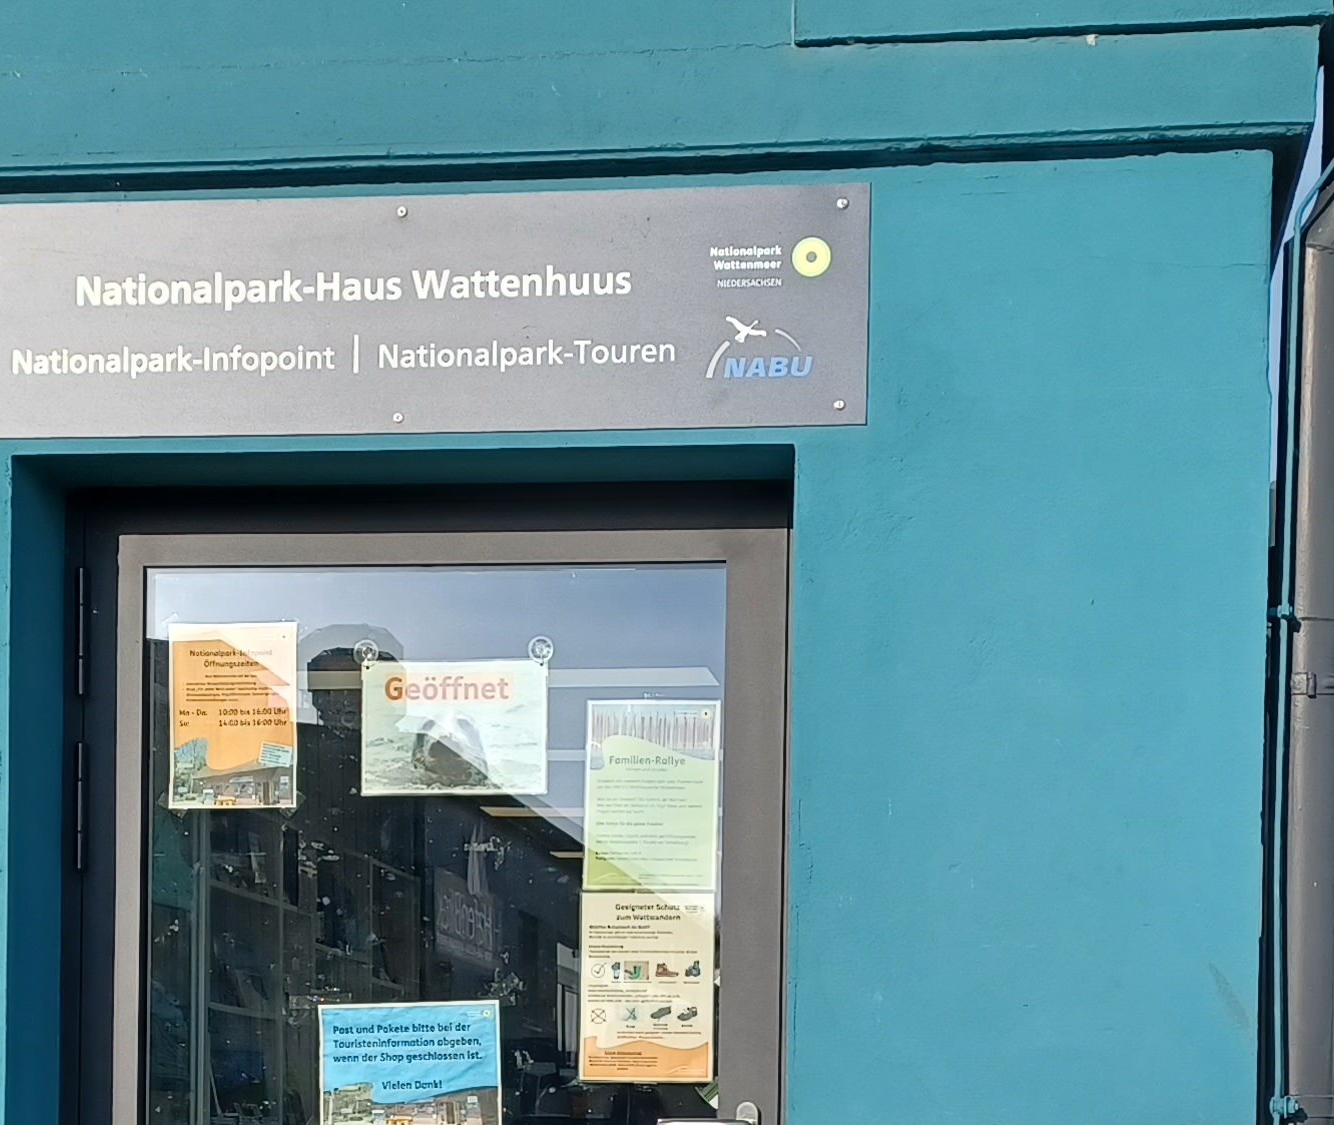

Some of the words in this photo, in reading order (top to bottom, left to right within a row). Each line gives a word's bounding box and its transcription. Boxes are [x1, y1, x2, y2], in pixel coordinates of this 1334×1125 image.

[710, 245, 782, 258] Nationalpark
[713, 260, 782, 271] Wattenmeer
[75, 270, 402, 311] Nationalpark-Haus
[412, 265, 632, 299] Wattenhuus
[717, 278, 782, 288] NIEDERSACHSEN
[12, 345, 335, 379] Nationalpark-Infopoint
[378, 339, 676, 372] Nationalpark-Touren
[724, 356, 813, 378] NABU
[203, 660, 259, 669] Öffnungszeiten
[384, 676, 510, 701] Geöffnet
[609, 755, 686, 767] Familien-Rallye
[615, 903, 655, 912] Geeigneter
[333, 1025, 354, 1035] Post
[355, 1024, 375, 1034] und
[377, 1024, 410, 1034] Pakete
[412, 1023, 436, 1033] bitte
[437, 1022, 453, 1032] bei
[455, 1022, 471, 1032] der
[333, 1038, 435, 1050] Touristeninformation
[437, 1037, 482, 1049] abgeben,
[333, 1054, 359, 1063] wenn
[361, 1053, 378, 1063] der
[379, 1053, 404, 1064] Shop
[405, 1052, 465, 1063] geschlossen
[381, 1081, 412, 1090] Vielen
[414, 1080, 443, 1090] Dank!
